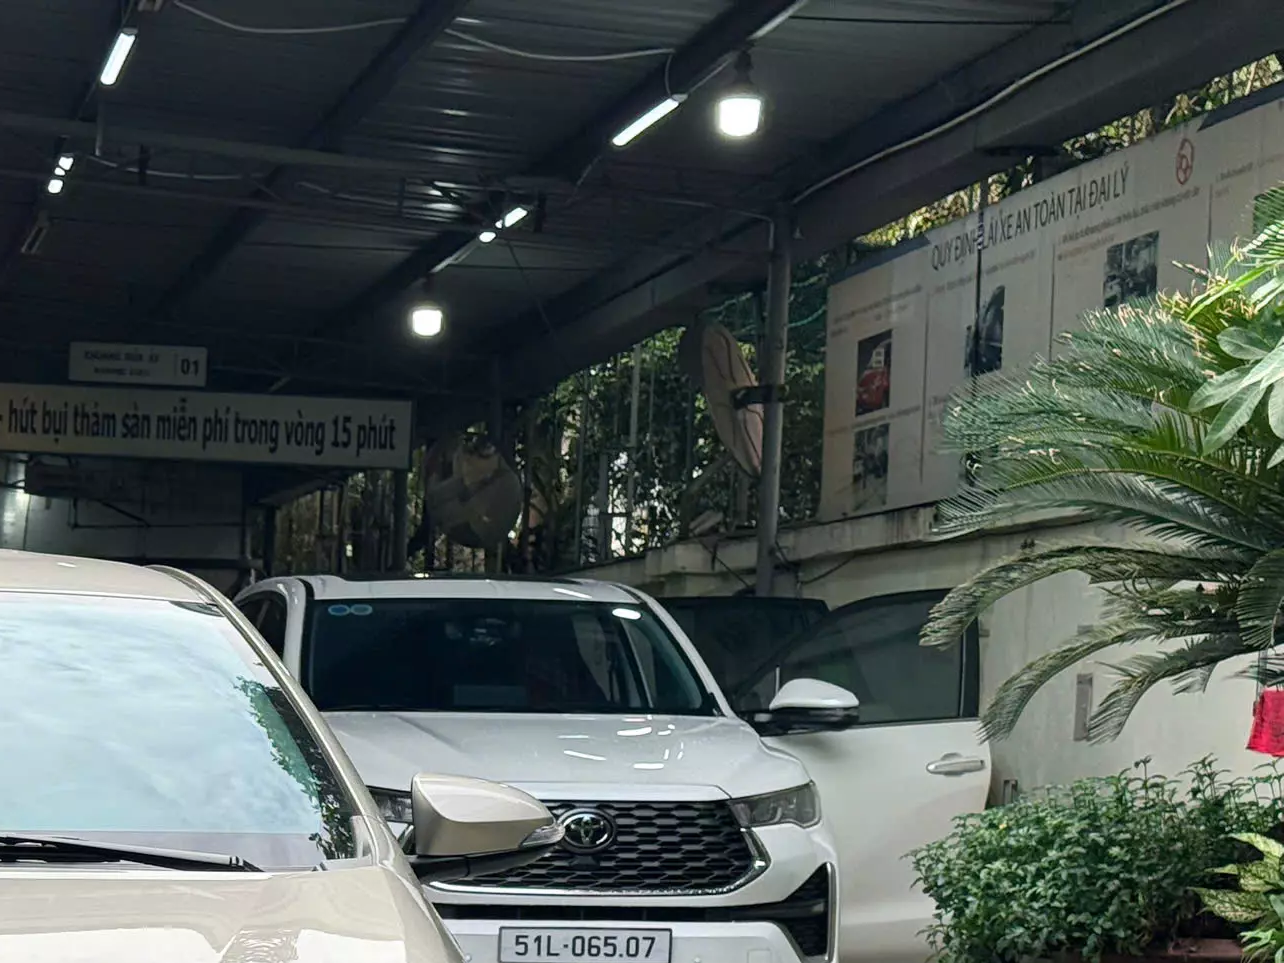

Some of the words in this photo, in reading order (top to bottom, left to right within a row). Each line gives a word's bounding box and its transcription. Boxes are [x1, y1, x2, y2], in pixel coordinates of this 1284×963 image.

[931, 240, 952, 271] QUY
[999, 214, 1013, 243] XE
[1015, 206, 1031, 237] AN
[1034, 192, 1066, 230] TOÀN
[1068, 182, 1086, 220] TẠI
[1089, 174, 1111, 211] ĐẠI
[1113, 161, 1130, 199] LÝ
[180, 358, 199, 377] 01
[8, 398, 38, 435] hút
[42, 400, 68, 444] bụi
[73, 400, 117, 438] thảm
[121, 402, 151, 439] sàn
[156, 398, 197, 442] miễn
[202, 406, 230, 451] phí
[234, 411, 279, 453] trong
[284, 410, 325, 455] vòng
[331, 415, 352, 448] 15
[356, 414, 396, 456] phút
[515, 934, 656, 958] 51L-065.07
